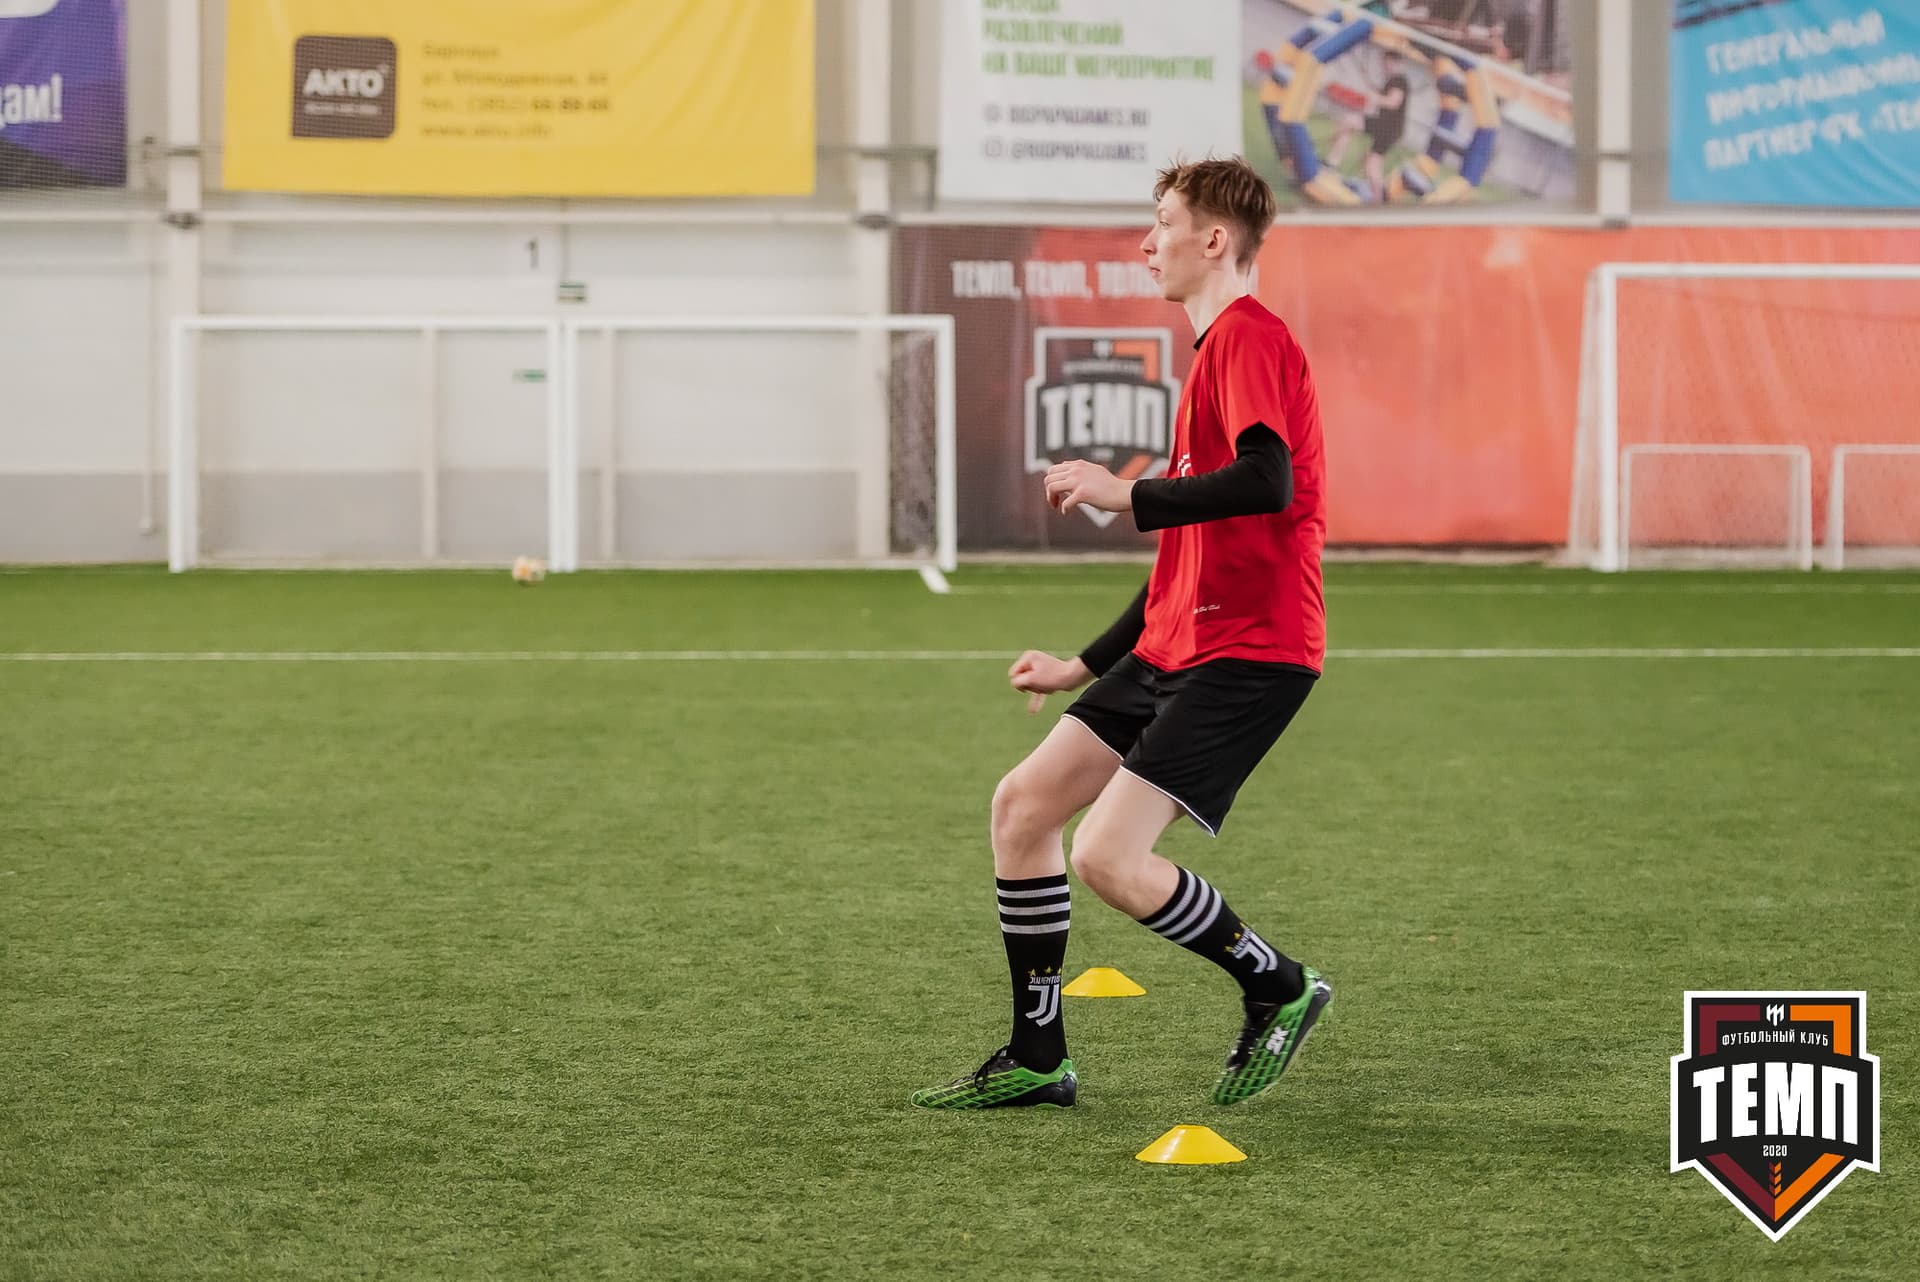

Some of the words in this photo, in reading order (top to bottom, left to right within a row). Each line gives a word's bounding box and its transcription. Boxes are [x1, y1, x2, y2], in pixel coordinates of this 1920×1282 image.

[0, 73, 63, 131] ам!
[951, 260, 1021, 299] ТЕМП,
[1024, 260, 1093, 299] ТЕМП,
[1041, 382, 1166, 450] ТЕМП
